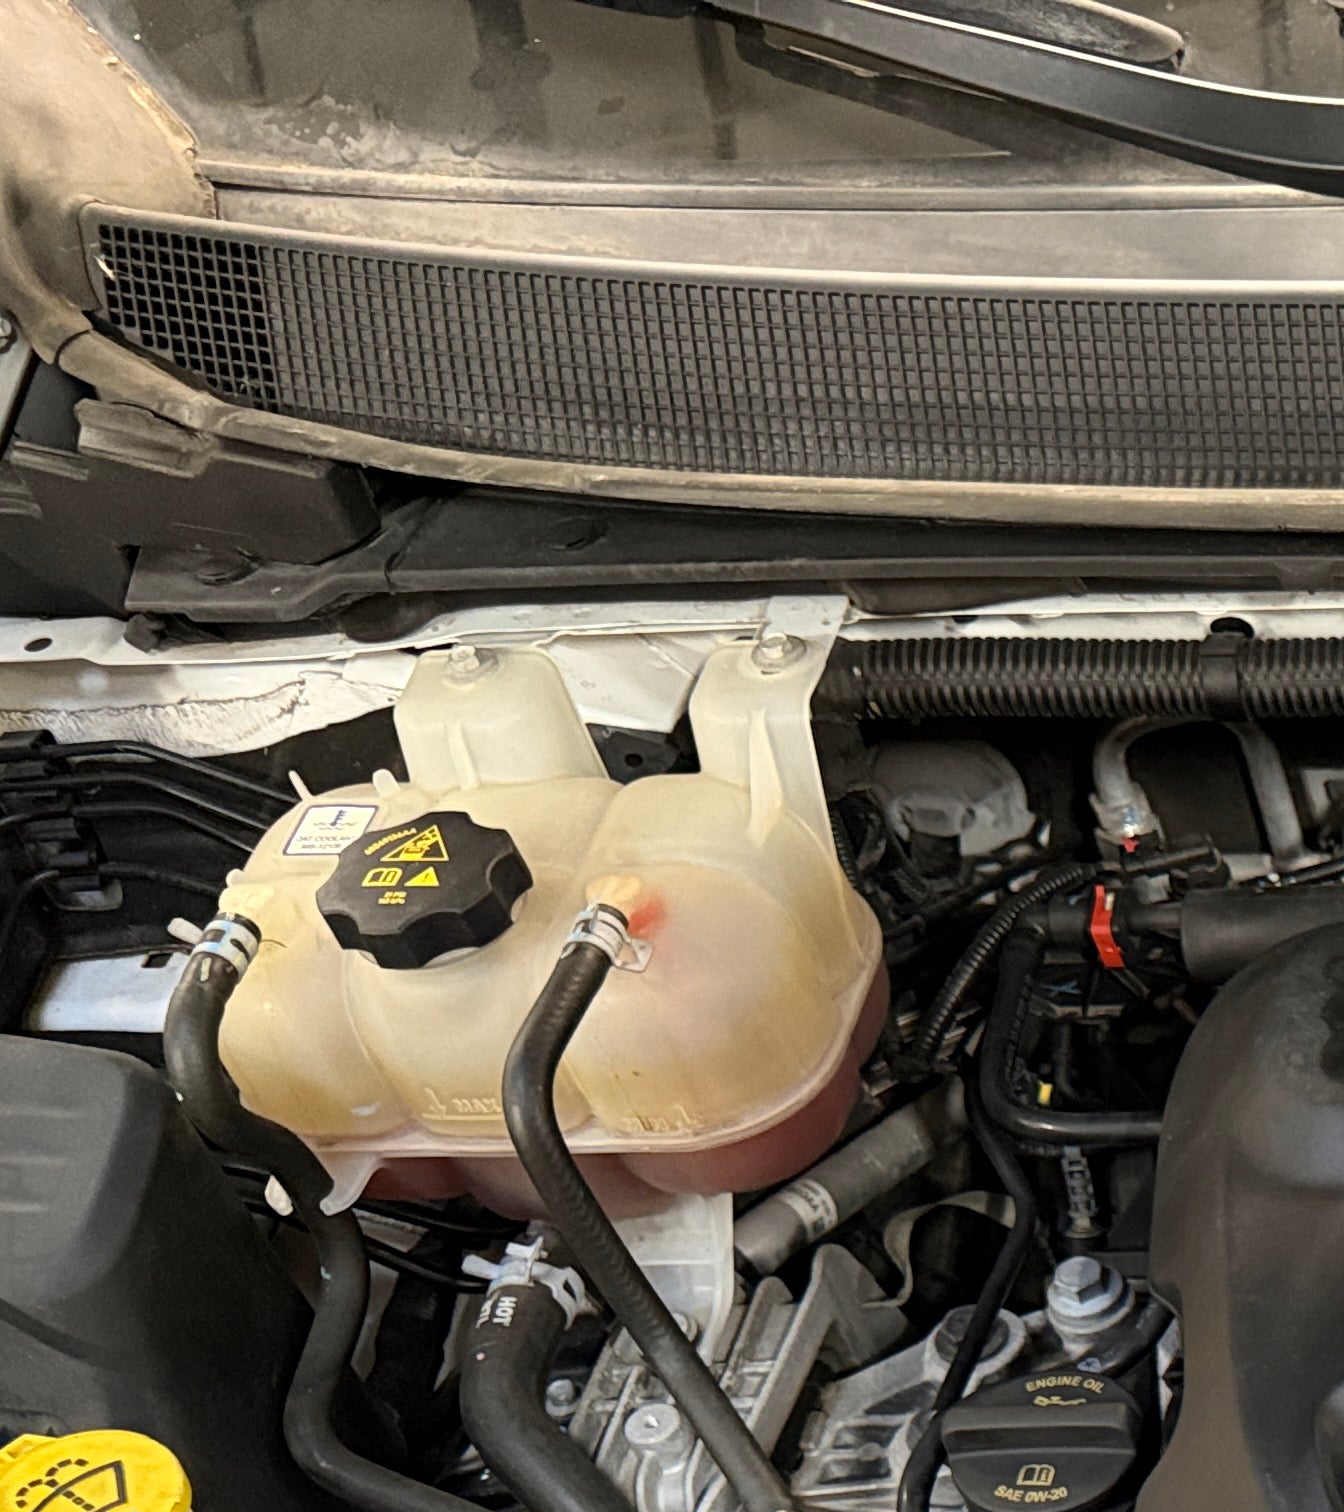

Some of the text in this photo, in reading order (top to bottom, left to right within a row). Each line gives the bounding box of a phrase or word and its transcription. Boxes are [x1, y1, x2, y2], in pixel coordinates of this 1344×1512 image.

[492, 1296, 518, 1327] HOT
[1026, 1376, 1104, 1394] ENGINE OIL
[994, 1485, 1068, 1503] SAE 0W-20
